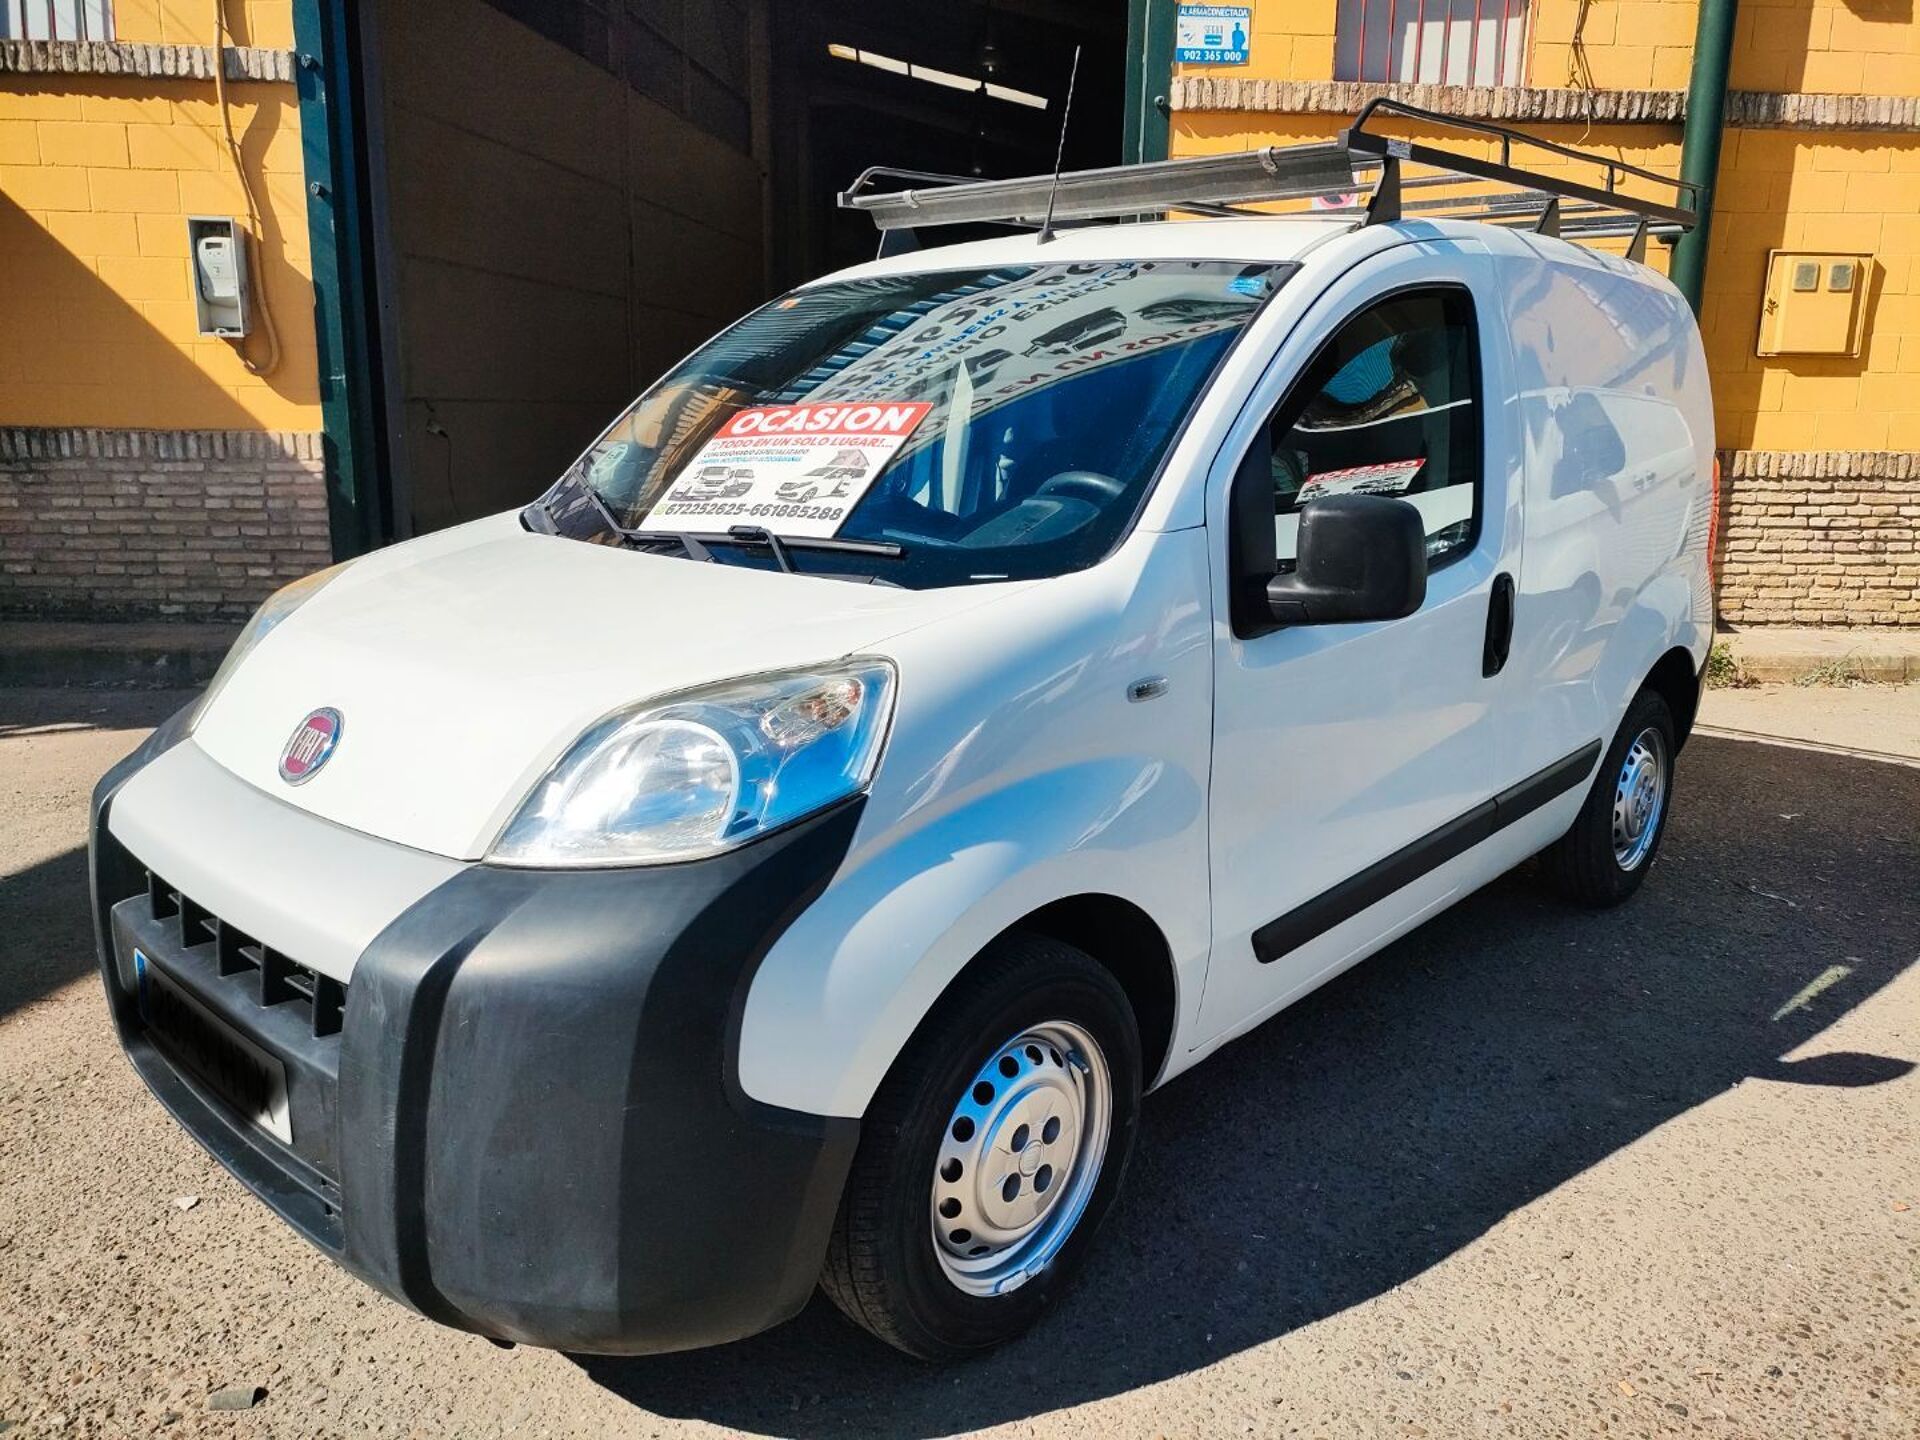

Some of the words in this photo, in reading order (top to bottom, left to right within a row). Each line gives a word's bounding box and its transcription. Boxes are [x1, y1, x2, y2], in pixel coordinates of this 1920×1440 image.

[1183, 50, 1201, 61] 902
[1204, 50, 1221, 61] 365
[1223, 51, 1242, 61] 000
[731, 406, 917, 435] OCASION
[752, 438, 771, 448] EN
[772, 437, 792, 447] UN
[792, 436, 830, 446] SOLO
[289, 726, 328, 765] FIAT
